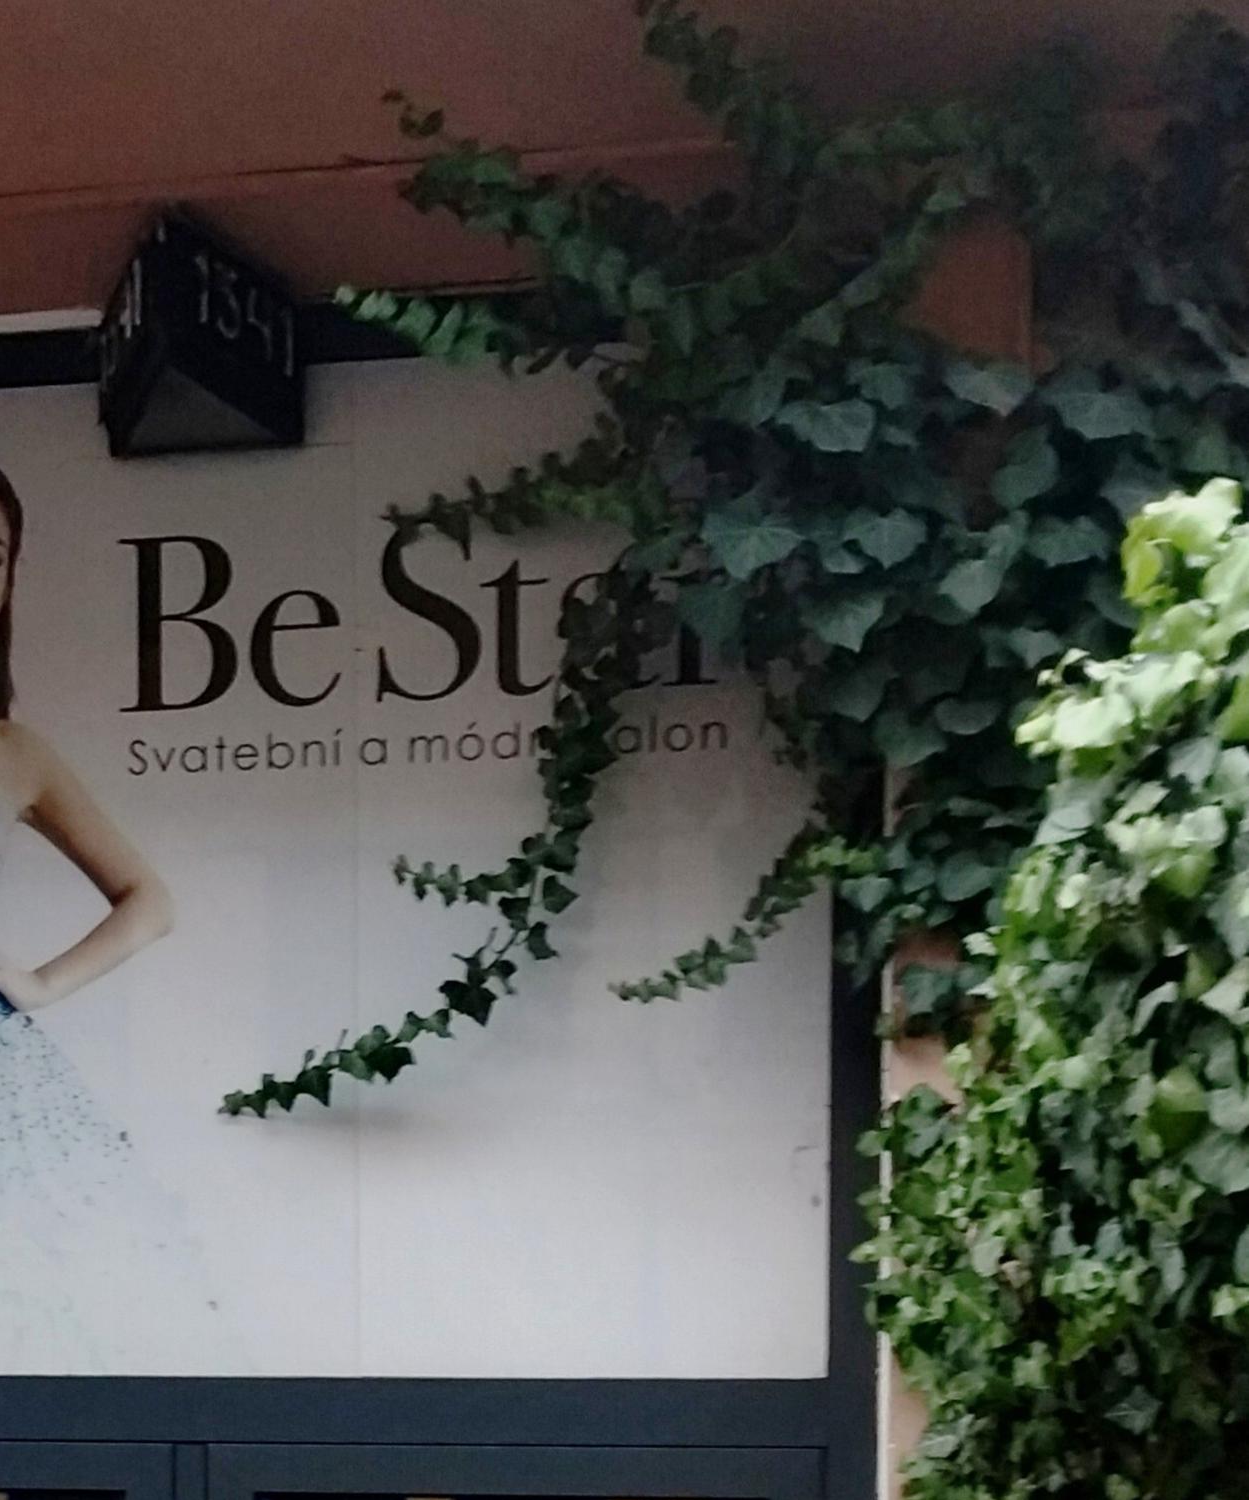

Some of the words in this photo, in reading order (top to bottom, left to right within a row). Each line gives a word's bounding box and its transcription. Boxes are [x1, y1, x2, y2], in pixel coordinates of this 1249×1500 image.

[128, 727, 342, 776] Svatební
[358, 733, 388, 766] a
[407, 720, 542, 764] mód
[614, 716, 729, 754] alon
